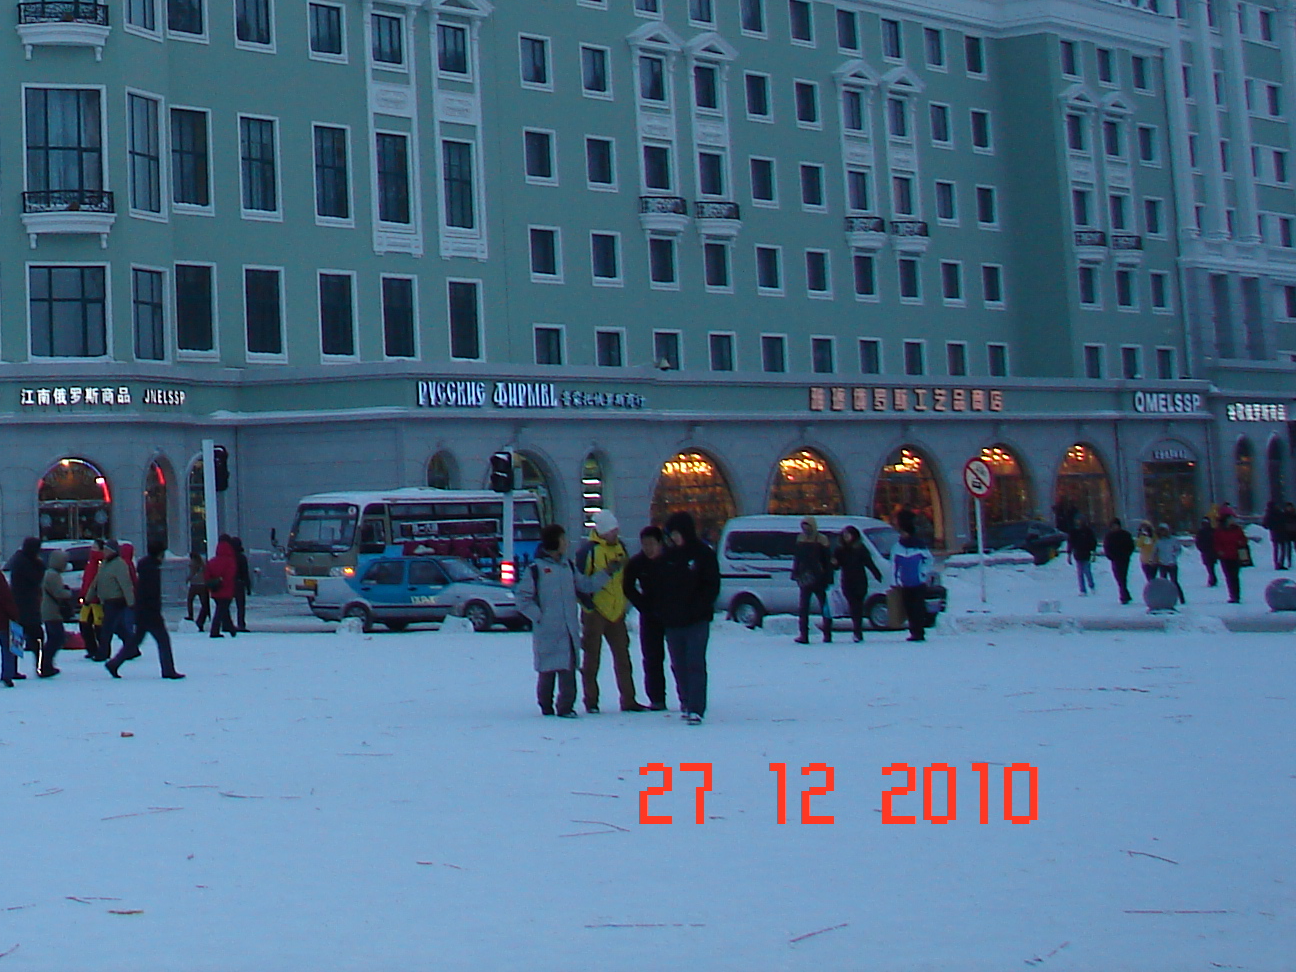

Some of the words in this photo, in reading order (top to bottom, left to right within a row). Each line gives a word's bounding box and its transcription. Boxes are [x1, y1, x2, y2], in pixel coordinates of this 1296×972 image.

[21, 386, 132, 406] 江南俄罗斯商品
[143, 389, 186, 406] JNELSSP
